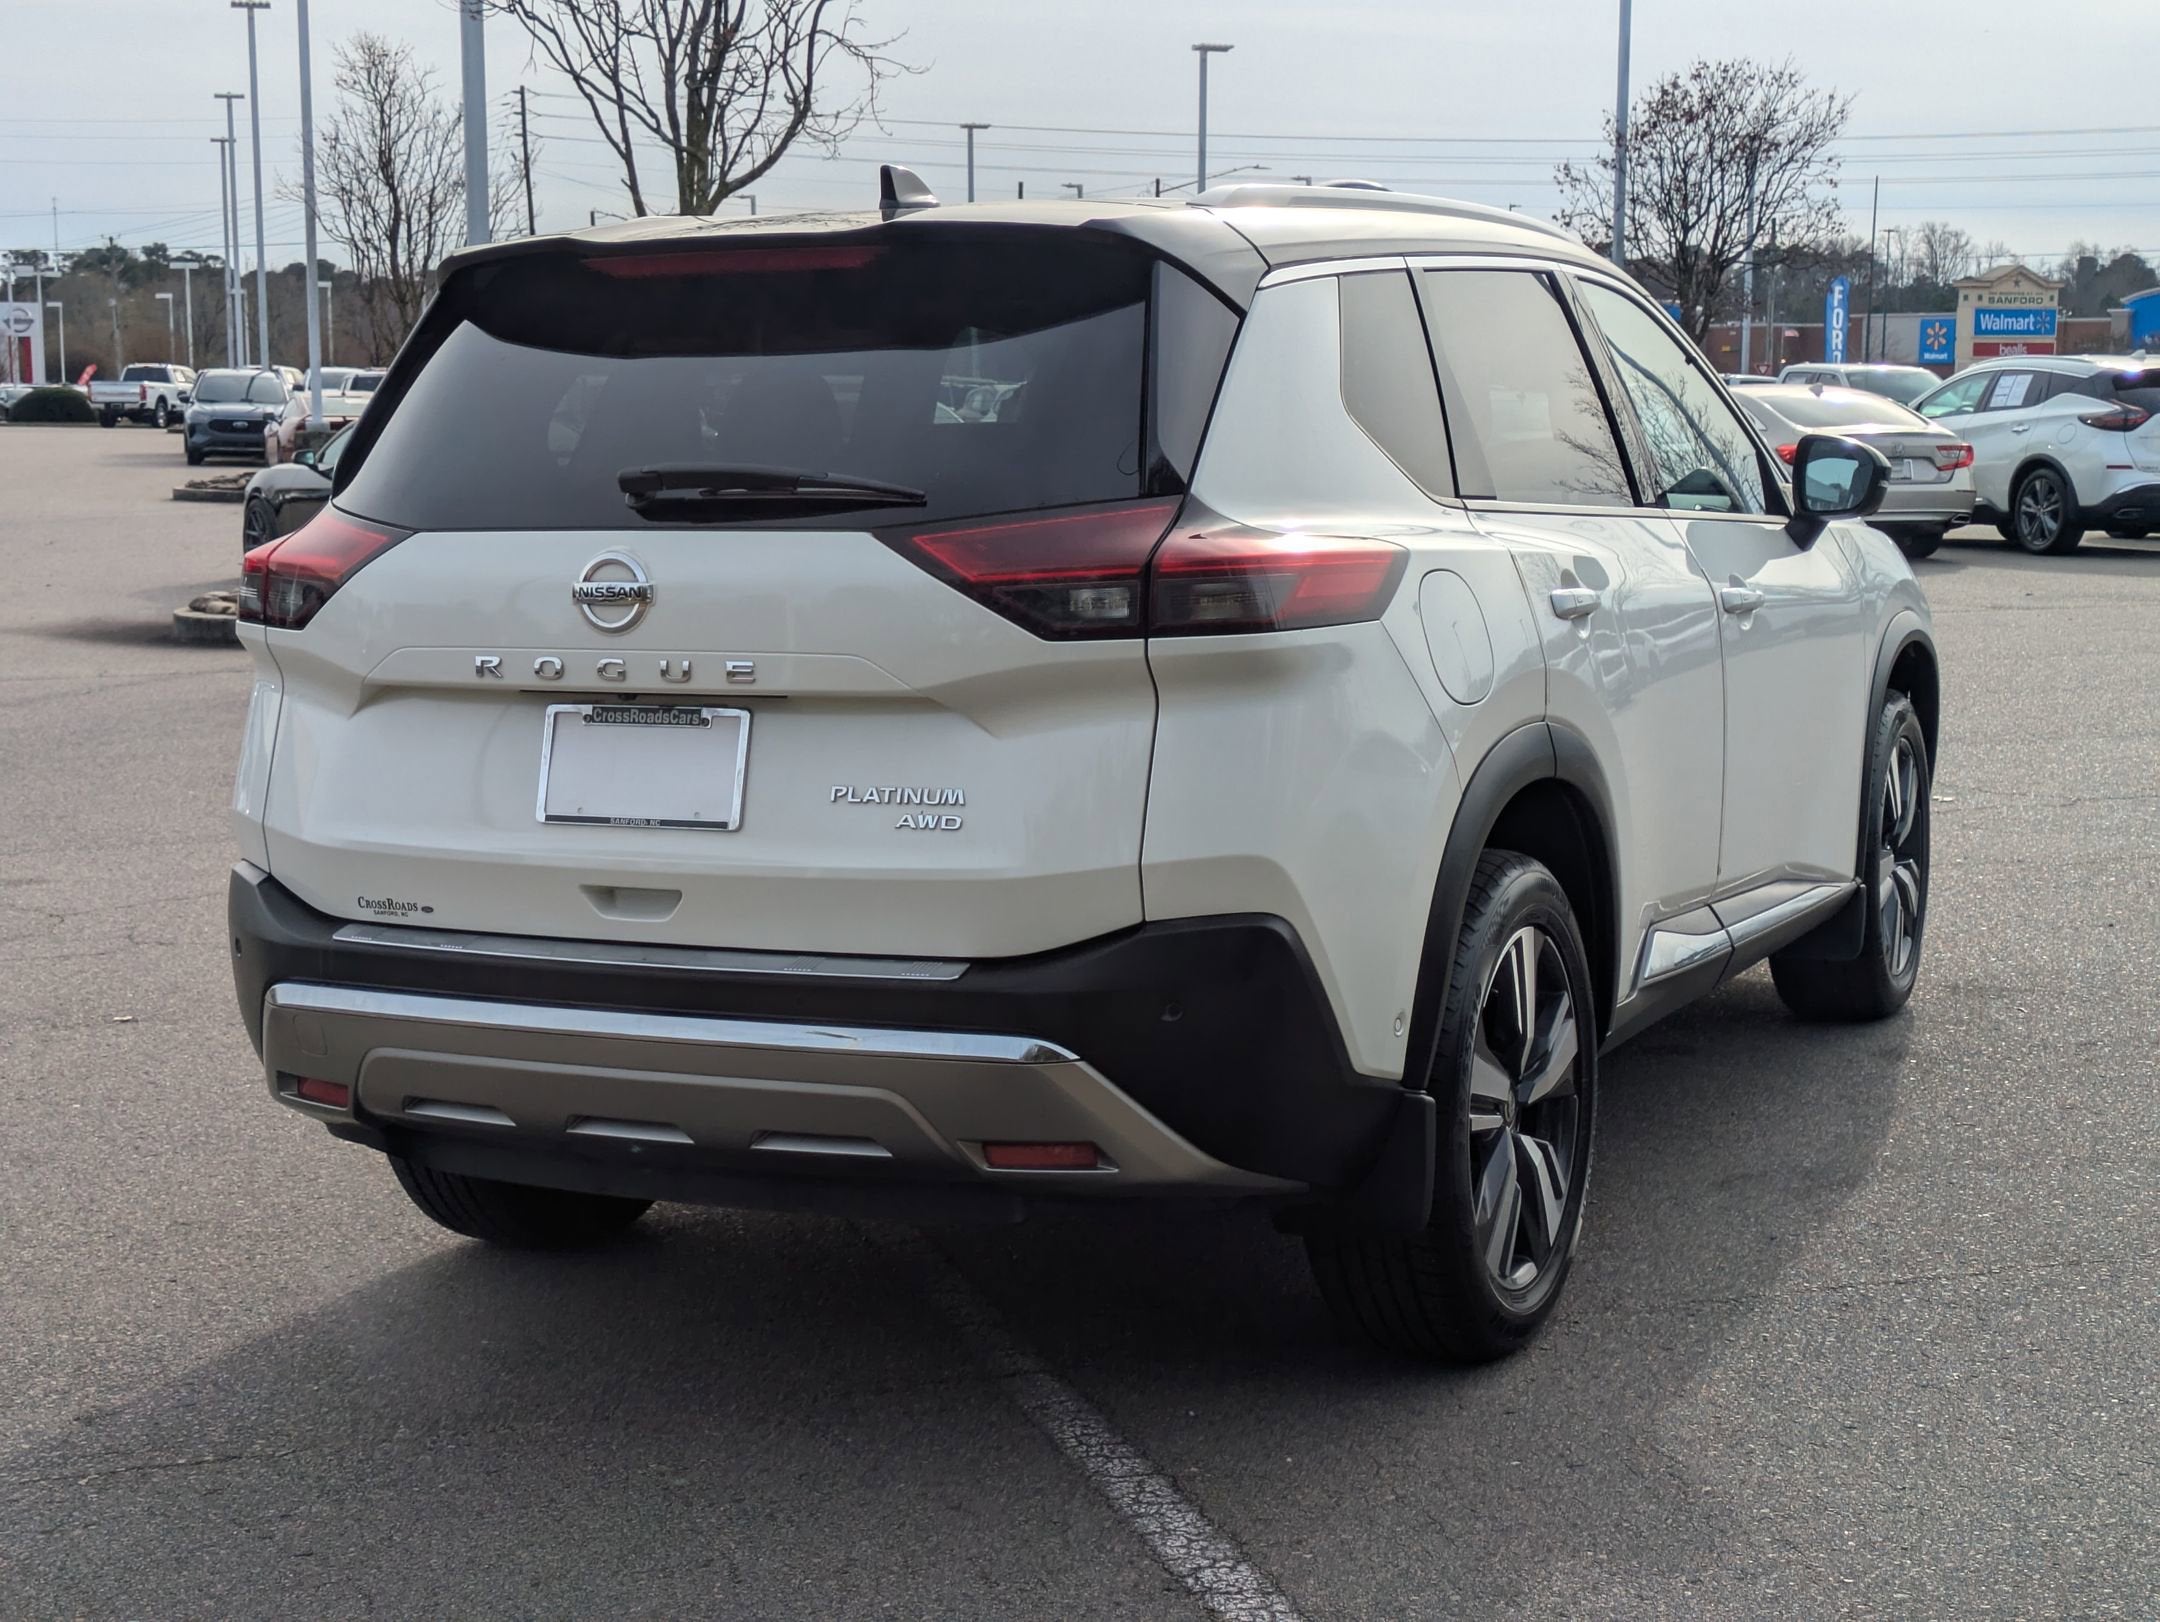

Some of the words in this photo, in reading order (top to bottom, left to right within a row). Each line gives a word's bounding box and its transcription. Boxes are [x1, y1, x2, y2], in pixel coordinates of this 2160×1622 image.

[1988, 296, 2044, 305] SANFORD
[1980, 313, 2035, 331] Walmart
[578, 586, 641, 598] NISSAN
[475, 655, 757, 684] ROGUE
[593, 708, 700, 725] CrossRoadsCars
[830, 785, 965, 806] PLATINUM
[895, 814, 962, 831] AWD
